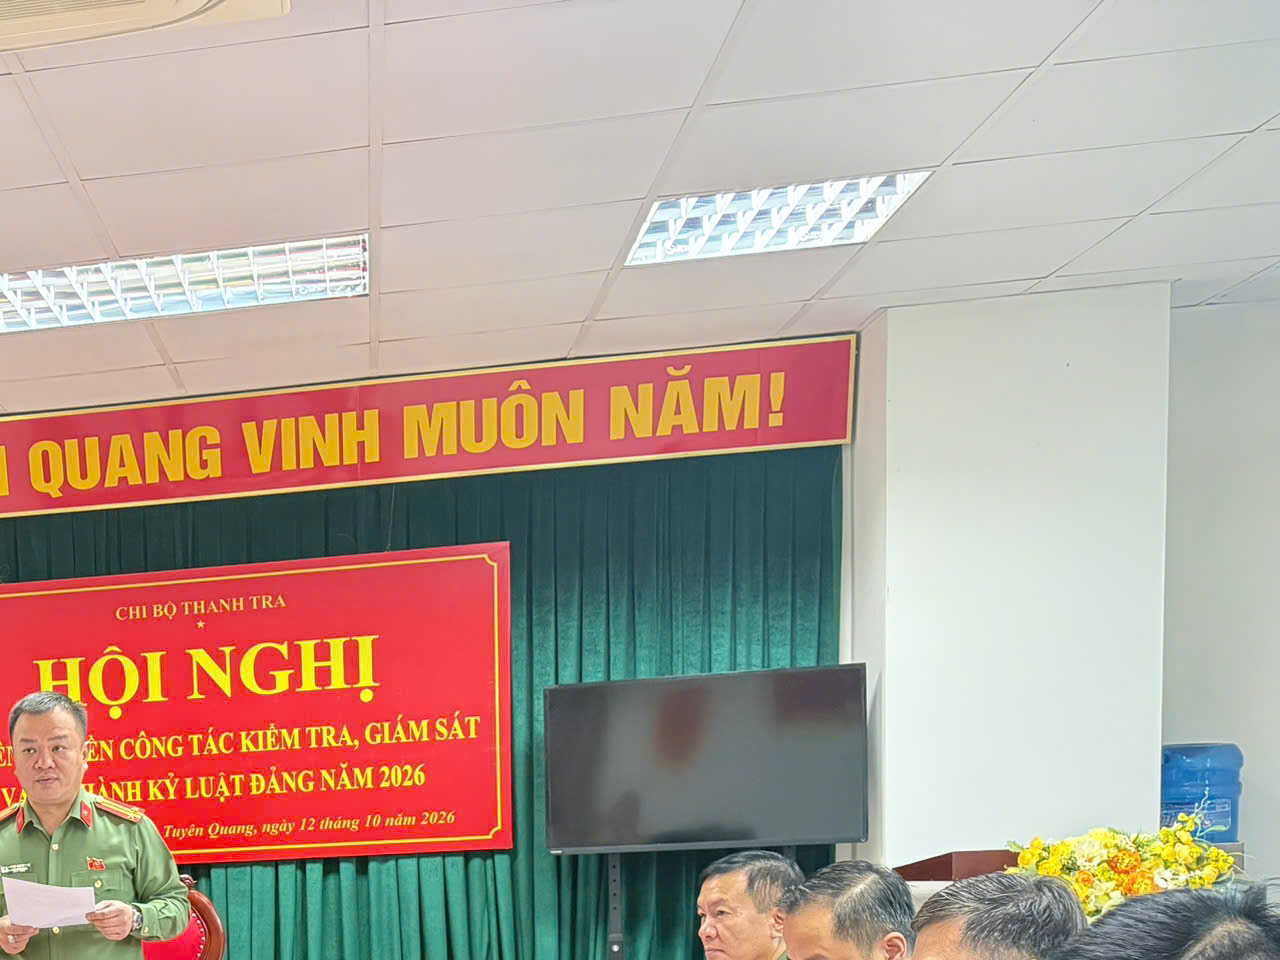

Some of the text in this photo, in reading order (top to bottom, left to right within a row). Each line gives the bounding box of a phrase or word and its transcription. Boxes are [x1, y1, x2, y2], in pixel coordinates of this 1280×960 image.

[28, 425, 223, 497] QUANG
[243, 409, 380, 474] VINH
[404, 380, 585, 458] MUÔN
[609, 365, 785, 440] NĂM!
[115, 594, 286, 621] CHI BỘ THANH TRA
[33, 634, 380, 719] HỘI NGHỊ
[119, 731, 184, 760] CÔNG
[188, 727, 234, 756] TÁC
[239, 723, 301, 753] KIỂM
[306, 725, 360, 750] TRA,
[364, 714, 429, 745] GIÁM
[435, 710, 481, 741] SÁT
[147, 772, 179, 801] KỶ
[185, 772, 245, 803] LUẬT
[250, 766, 315, 796] ĐẢNG
[320, 762, 374, 791] NĂM
[379, 763, 426, 788] 2026
[164, 810, 456, 841] Tuyên Quang, ngày 12 tháng 10 năm 2026
